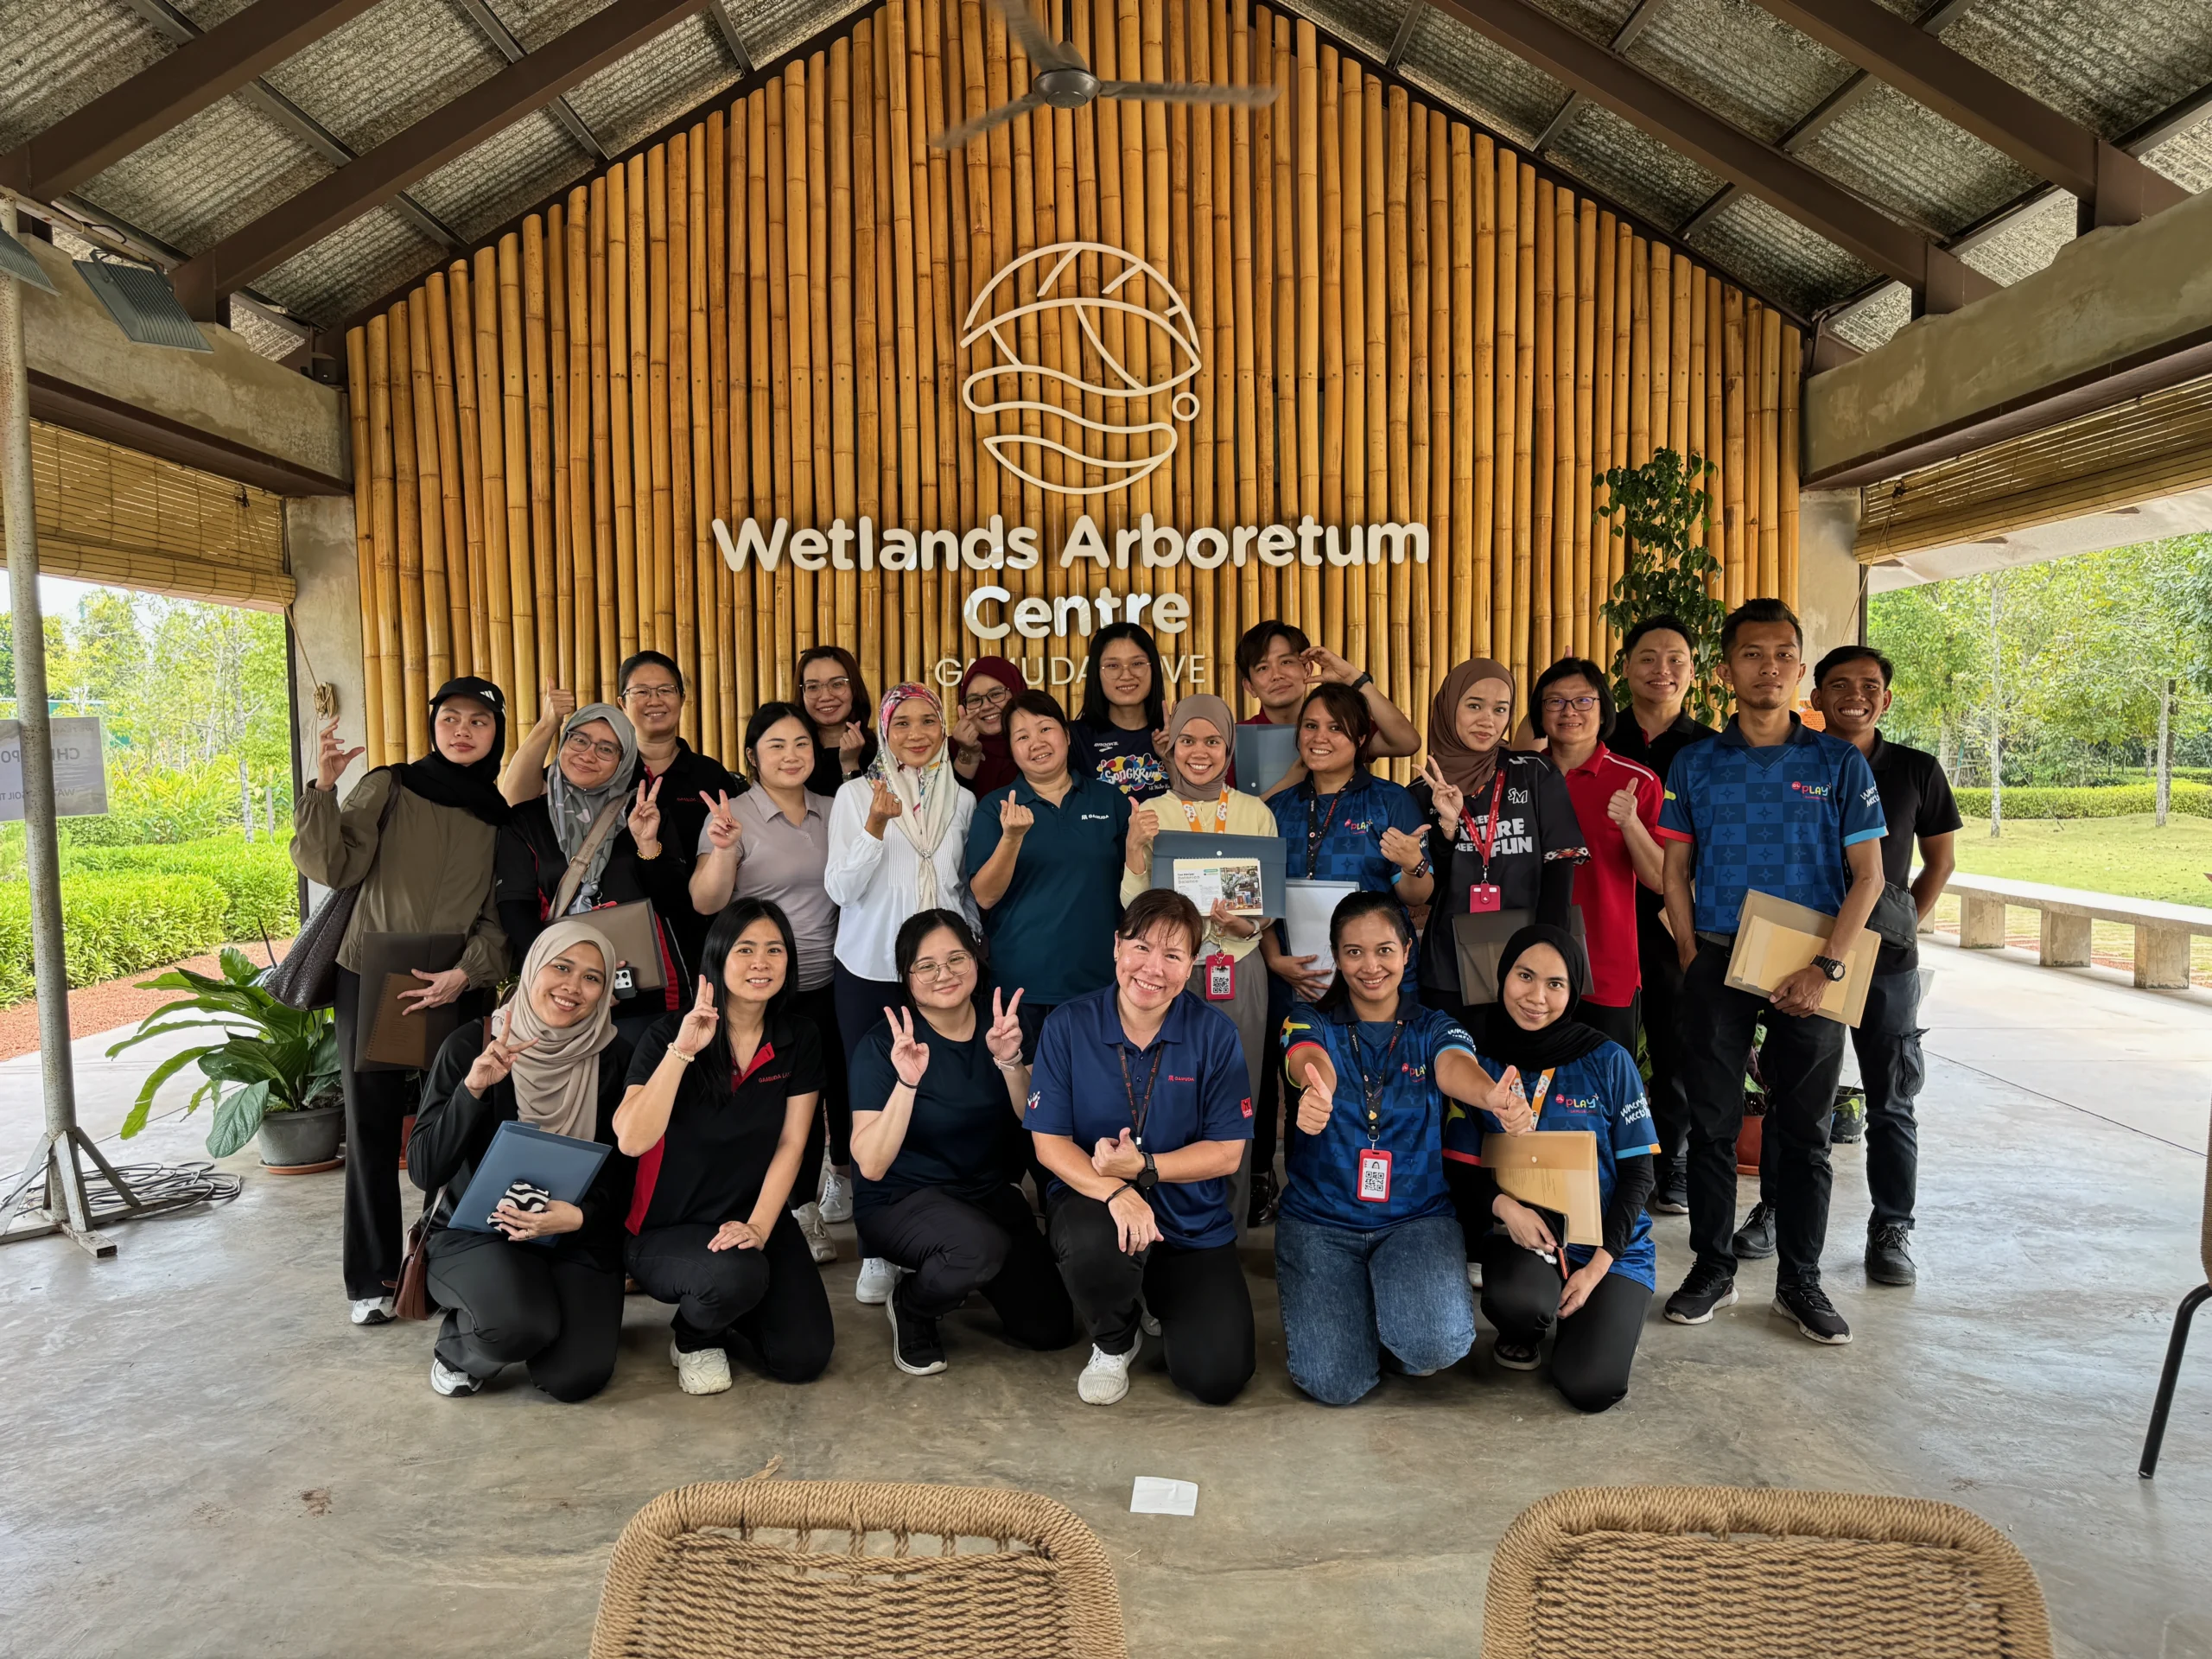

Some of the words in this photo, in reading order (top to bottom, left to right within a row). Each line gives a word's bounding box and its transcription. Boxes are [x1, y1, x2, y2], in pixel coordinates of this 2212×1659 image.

[712, 514, 1039, 573] Wetlands
[1059, 512, 1430, 570] Arboretum
[963, 585, 1191, 639] Centre
[934, 656, 1090, 687] GUDA
[1507, 787, 1529, 804] SM
[1491, 836, 1533, 858] FUN
[758, 1074, 781, 1084] GAMUDA
[1566, 1097, 1596, 1109] PLAY
